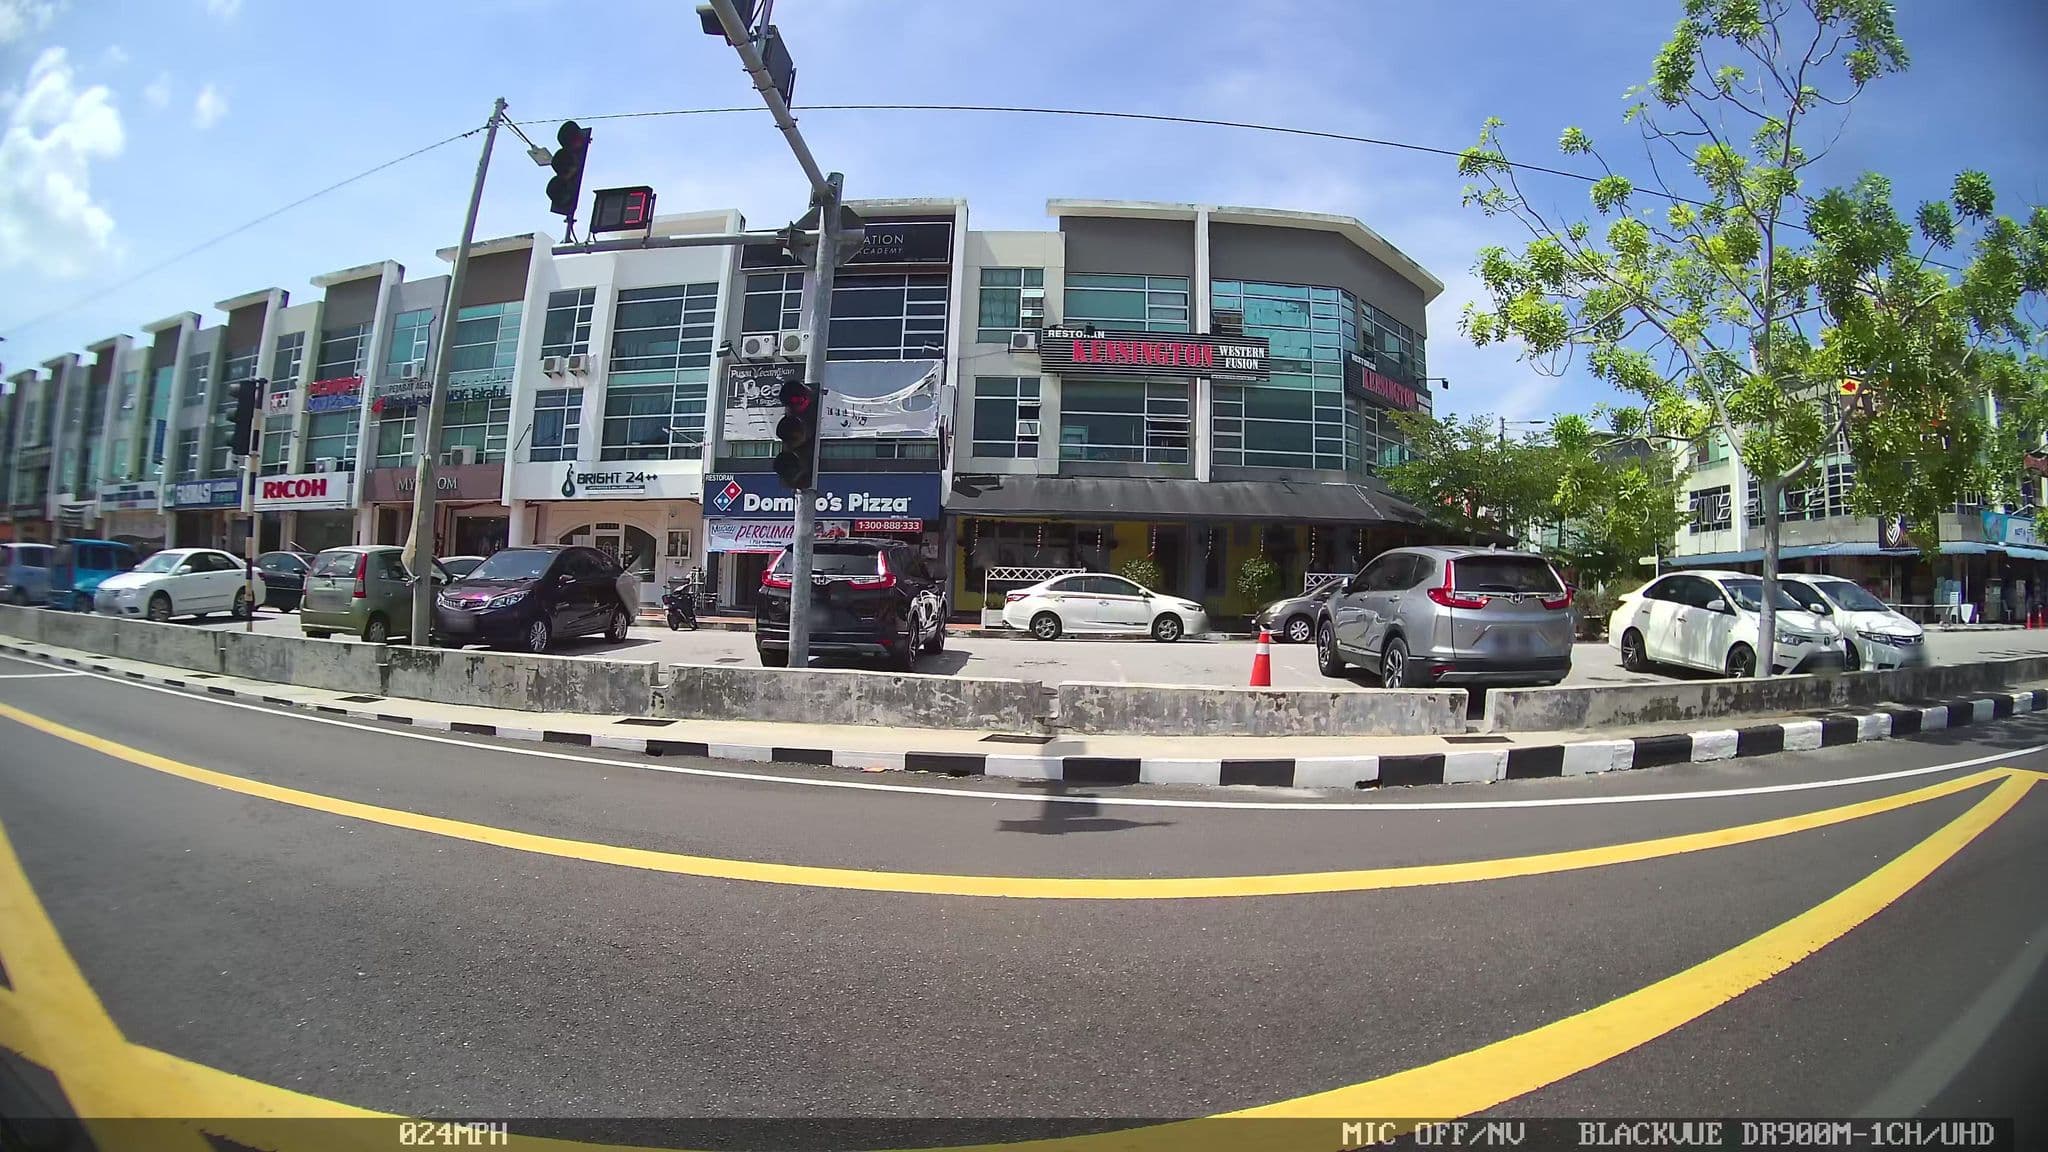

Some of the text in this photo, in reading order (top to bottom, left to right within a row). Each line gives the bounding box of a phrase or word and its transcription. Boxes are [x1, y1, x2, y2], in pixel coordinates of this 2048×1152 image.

[625, 192, 646, 224] 3
[863, 234, 904, 245] ATION
[1072, 338, 1213, 368] KENSINGTON
[1219, 345, 1265, 358] WESTERN
[1225, 358, 1259, 370] FUSION
[576, 471, 658, 485] BRIGHT 24++
[705, 474, 735, 482] RESTORAN
[262, 478, 328, 499] RICOH
[743, 491, 909, 512] Domo's Pizza
